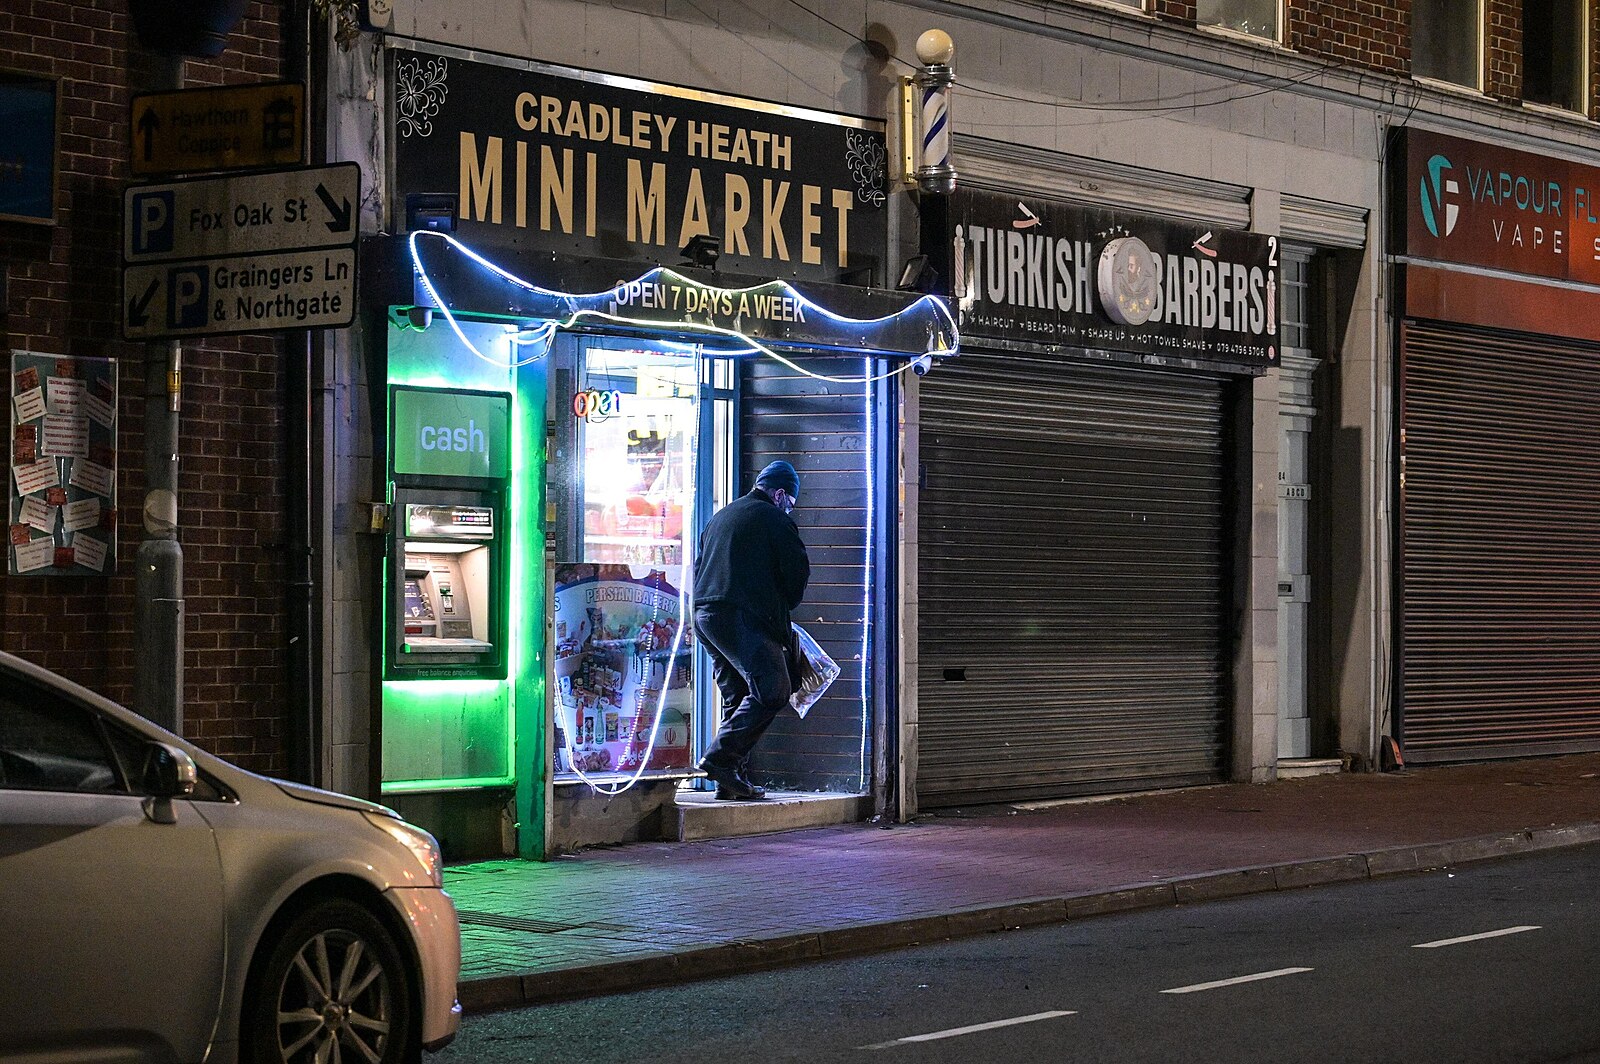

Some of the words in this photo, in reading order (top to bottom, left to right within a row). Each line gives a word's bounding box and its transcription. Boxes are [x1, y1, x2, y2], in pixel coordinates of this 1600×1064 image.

[515, 92, 677, 153] CRADLEY
[687, 119, 792, 172] HEATH
[459, 131, 598, 238] MINI
[626, 159, 854, 269] MARKET
[1466, 165, 1562, 217] VAPOUR
[1575, 187, 1598, 224] FL
[190, 209, 223, 232] Fox
[234, 203, 273, 227] Oak
[284, 199, 308, 222] St
[1267, 236, 1278, 267] 2
[1492, 219, 1563, 254] VAPE
[214, 264, 313, 290] Graingers
[324, 257, 348, 282] Ln
[968, 225, 1093, 315] TURKISH
[1149, 252, 1265, 335] BARBERS
[214, 302, 226, 321] &
[237, 291, 342, 320] Northgate
[614, 280, 667, 310] OPEN
[671, 286, 682, 311] 7
[686, 288, 734, 317] DAYS
[738, 293, 751, 318] A
[753, 294, 806, 324] WEEK
[978, 315, 1014, 329] HAIRCUT
[1027, 321, 1054, 333] BEARD
[1057, 324, 1076, 336] TRIM
[1088, 328, 1114, 341] SHAPE
[1115, 332, 1125, 342] UP
[1137, 334, 1153, 345] HOT
[1155, 336, 1180, 348] TOWEL
[1182, 339, 1206, 351] SHAVE
[421, 420, 485, 455] cash
[585, 586, 633, 604] PERSIAN
[634, 588, 677, 615] BAKERY
